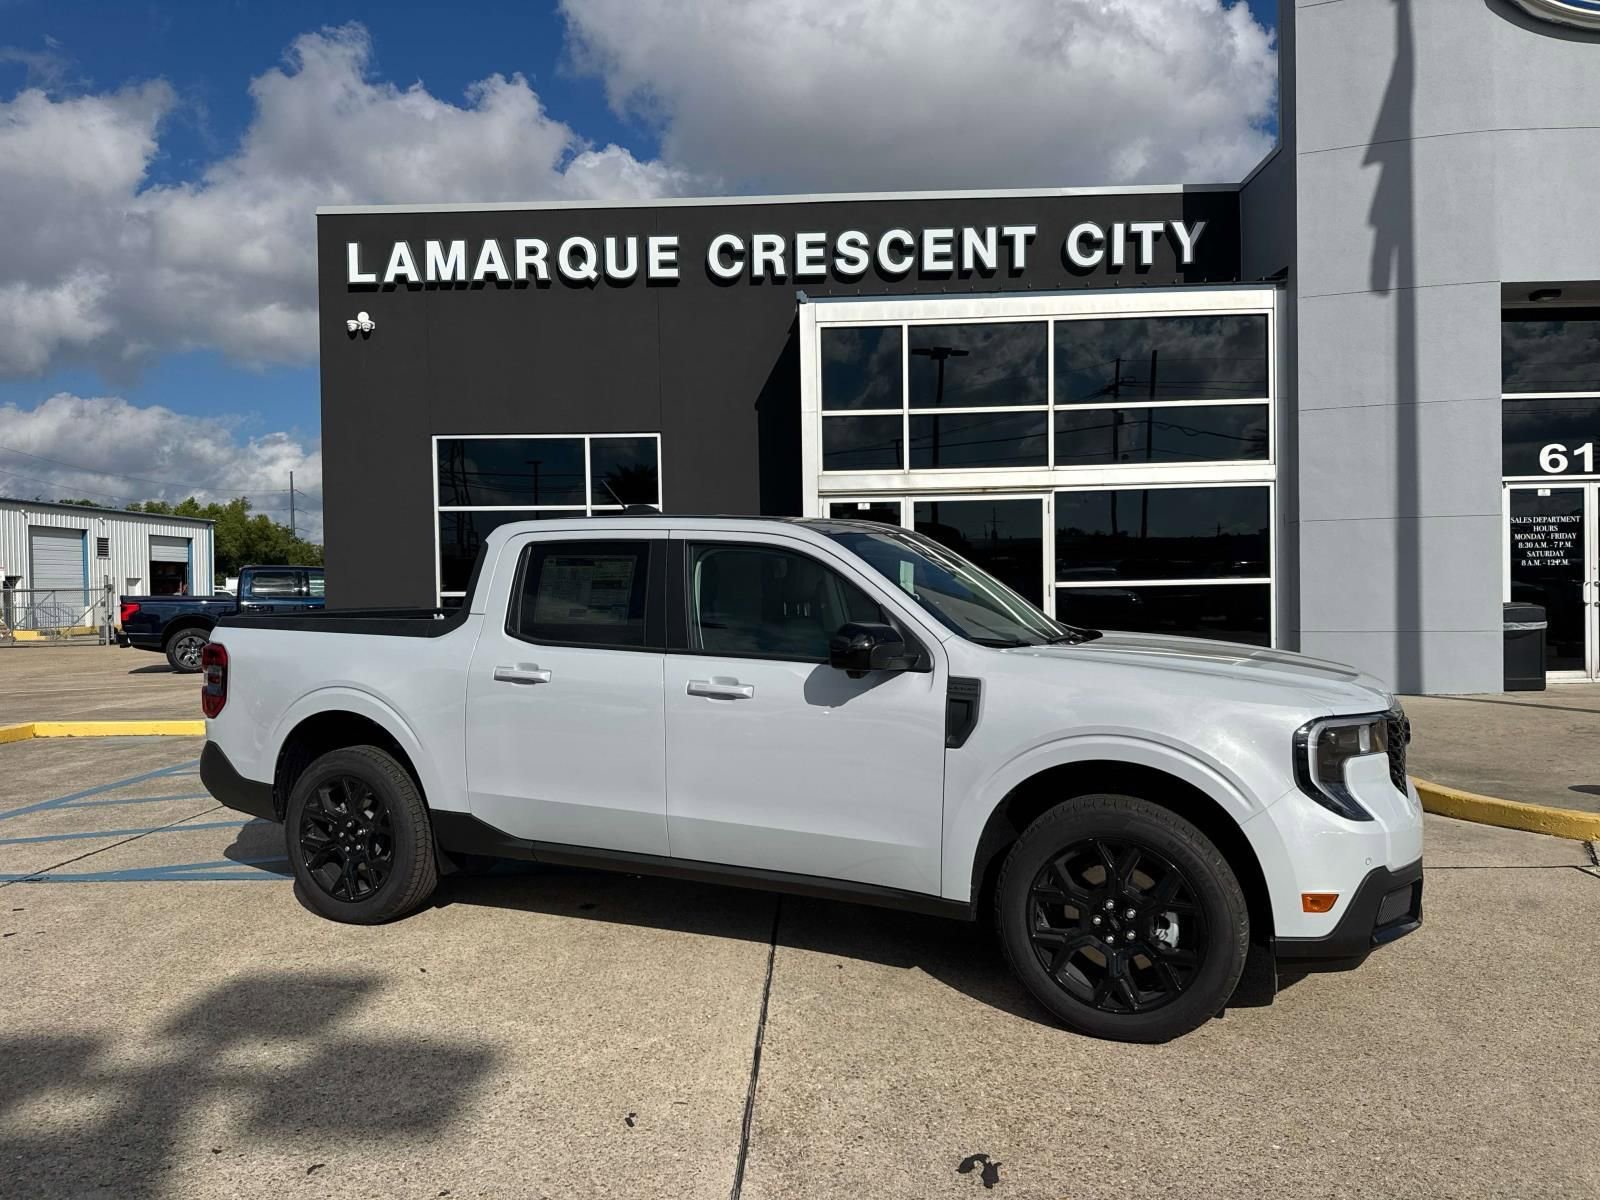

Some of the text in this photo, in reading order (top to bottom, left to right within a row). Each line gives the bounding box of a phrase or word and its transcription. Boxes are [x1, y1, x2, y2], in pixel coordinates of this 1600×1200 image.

[346, 220, 1206, 285] LAMARQUE CRESCENT CITY
[1539, 443, 1593, 473] 61
[1510, 515, 1580, 524] SALES DEPARTMENT
[1550, 532, 1577, 540] FRIDAY
[1534, 541, 1549, 549] A.M.
